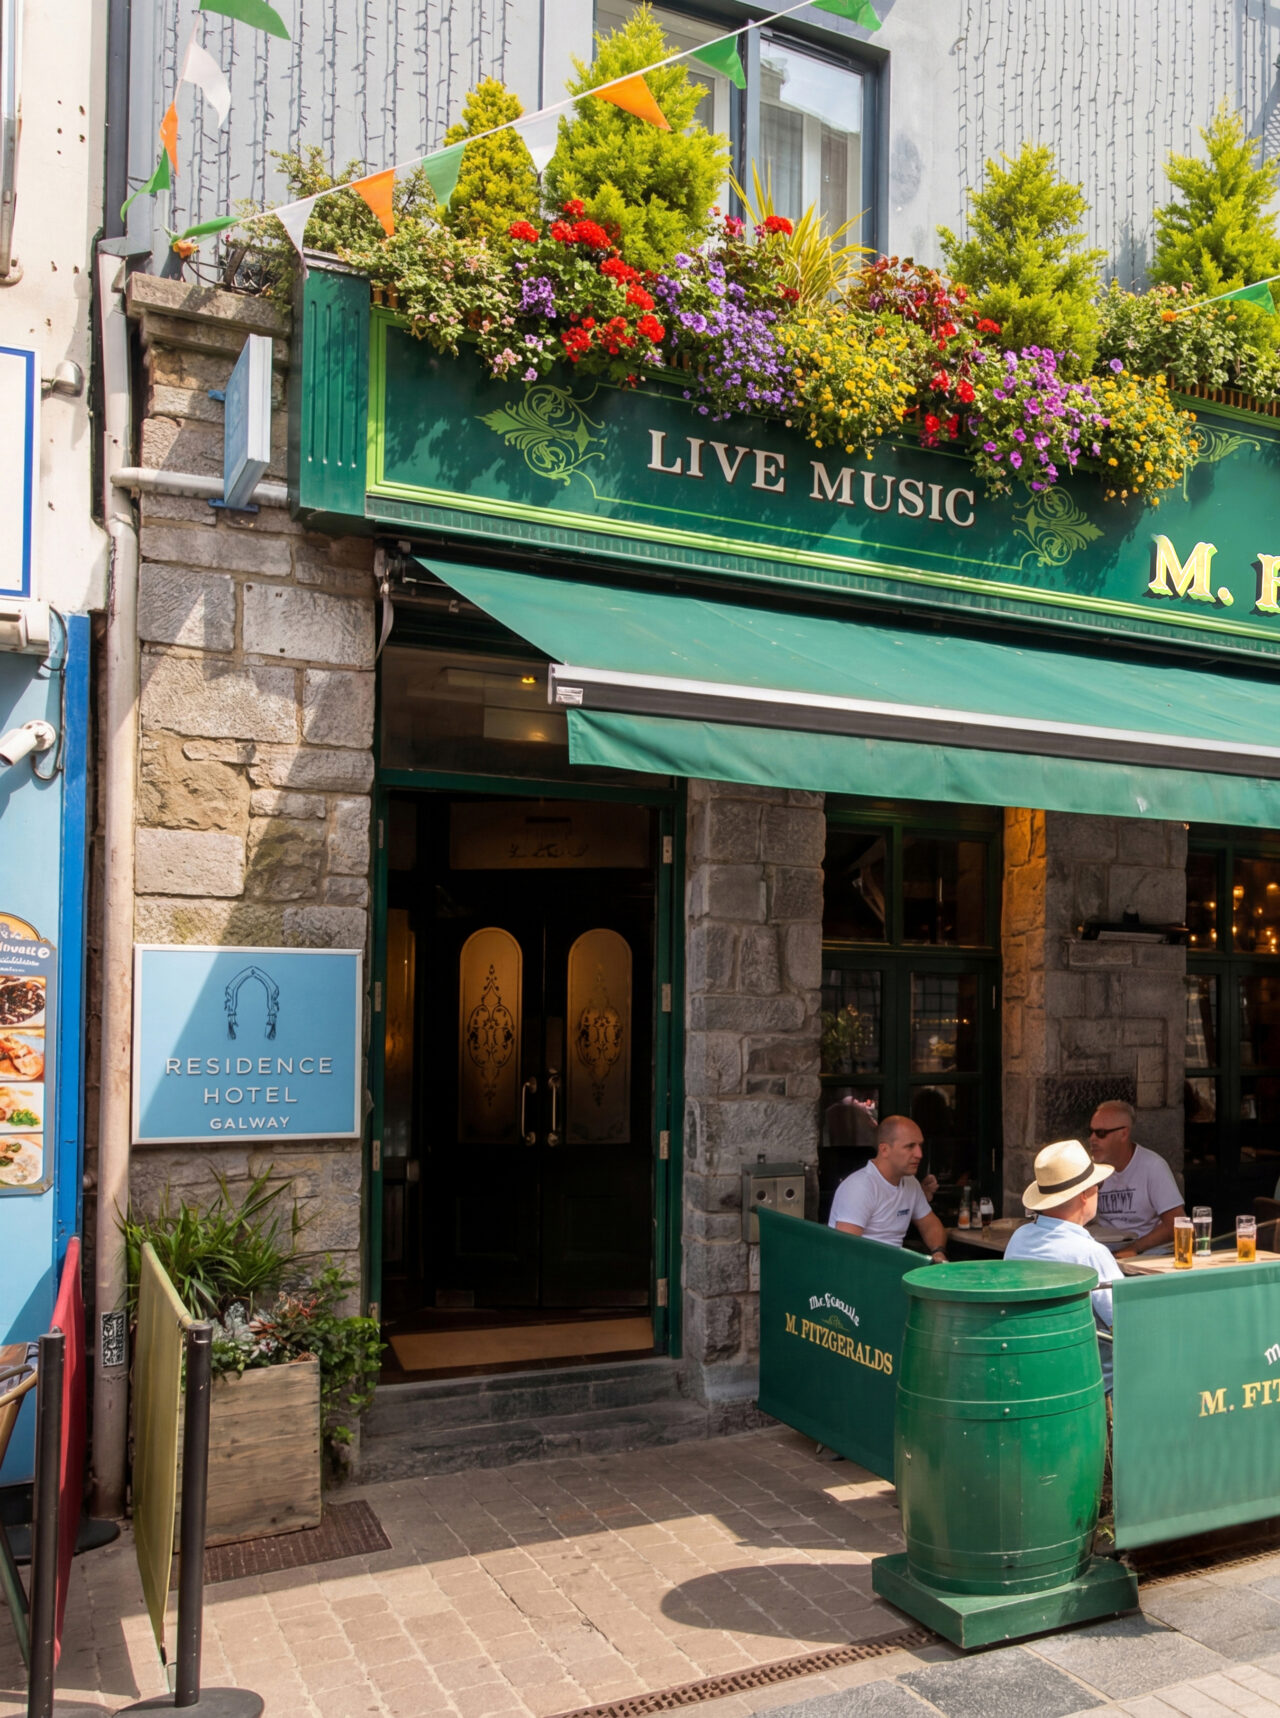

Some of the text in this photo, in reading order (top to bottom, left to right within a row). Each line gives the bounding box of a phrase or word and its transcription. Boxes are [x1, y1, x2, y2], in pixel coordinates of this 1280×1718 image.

[648, 429, 975, 527] LIVE MUSIC
[1149, 534, 1234, 606] M.
[166, 1057, 333, 1075] RESIDENCE
[203, 1087, 298, 1104] HOTEL
[209, 1116, 291, 1130] GALWAY
[784, 1312, 798, 1335] M.
[1199, 1388, 1235, 1417] M.
